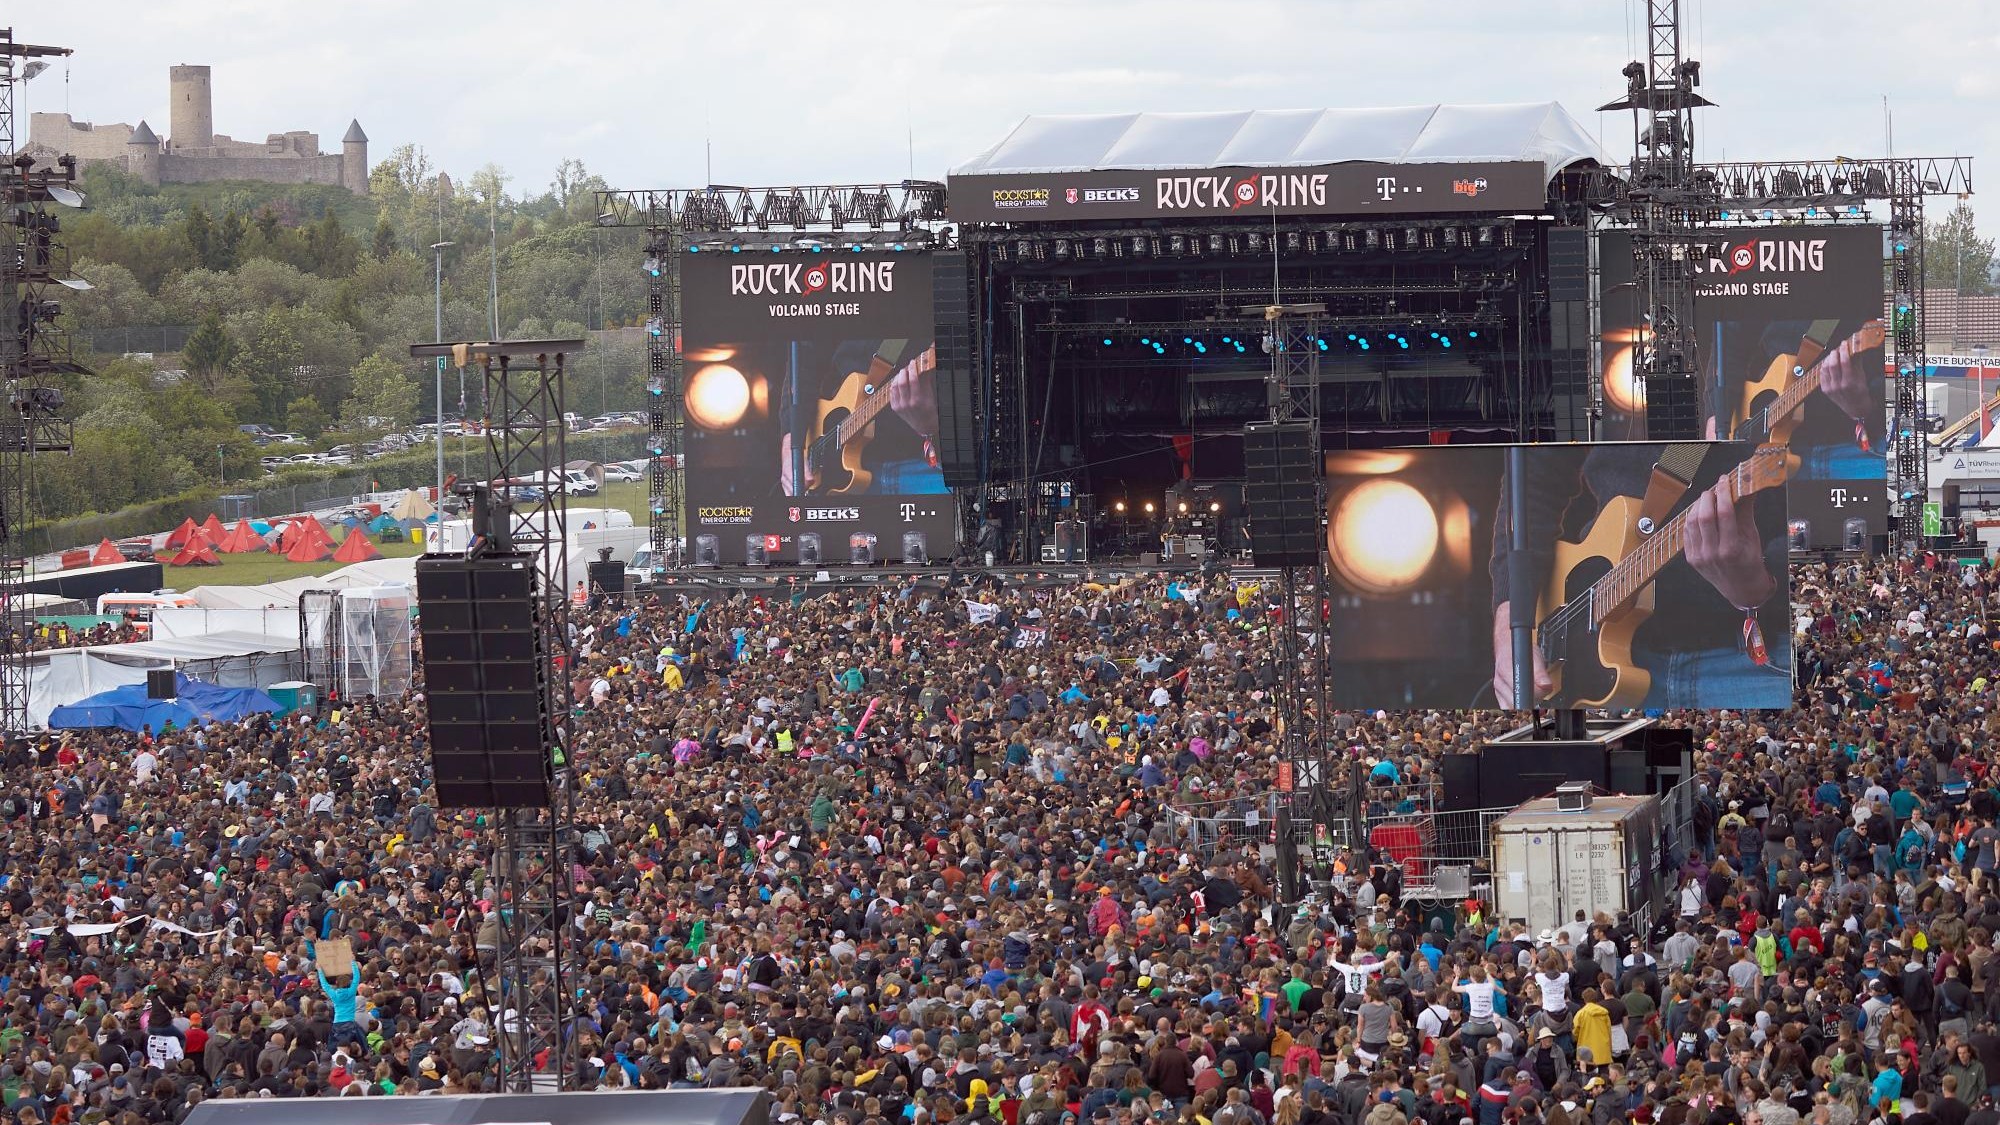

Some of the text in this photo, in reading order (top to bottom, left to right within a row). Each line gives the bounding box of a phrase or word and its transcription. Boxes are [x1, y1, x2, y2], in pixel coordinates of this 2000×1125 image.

[1085, 188, 1140, 201] BECK'S
[1157, 177, 1231, 209] ROCK
[1261, 175, 1328, 207] RING
[1759, 239, 1827, 272] RING
[731, 263, 803, 295] ROCK
[831, 261, 896, 293] RING
[1752, 282, 1789, 295] STAGE
[769, 303, 860, 317] VOLCANO STAGE
[806, 508, 859, 520] BECK'S
